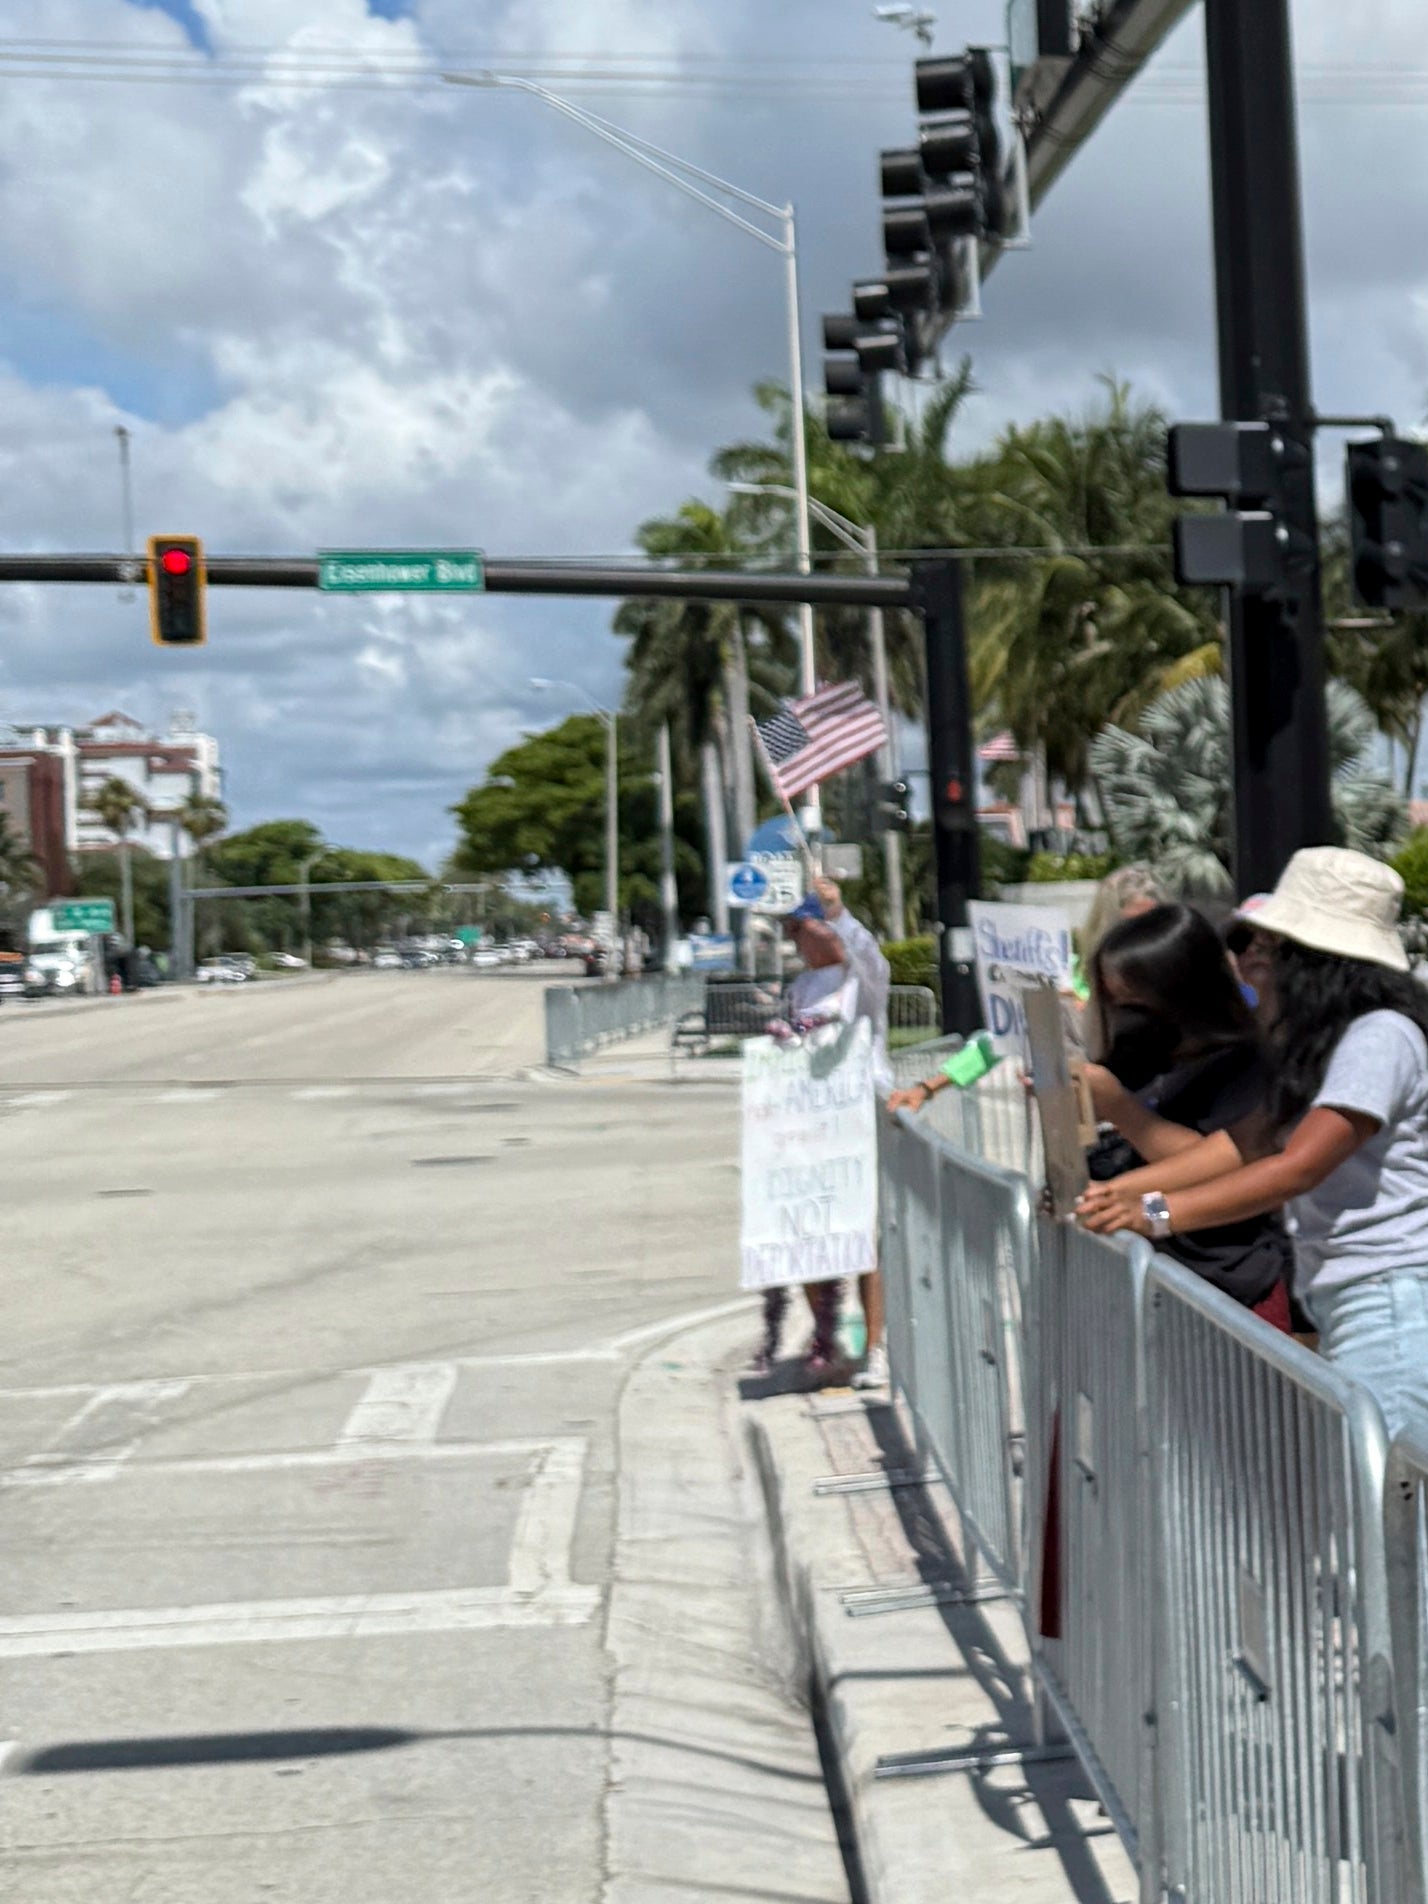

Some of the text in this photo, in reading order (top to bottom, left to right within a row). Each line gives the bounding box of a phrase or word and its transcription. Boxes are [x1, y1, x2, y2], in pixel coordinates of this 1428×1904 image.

[326, 559, 479, 584] Eisenhower Blvd
[780, 1195, 834, 1240] NOT
